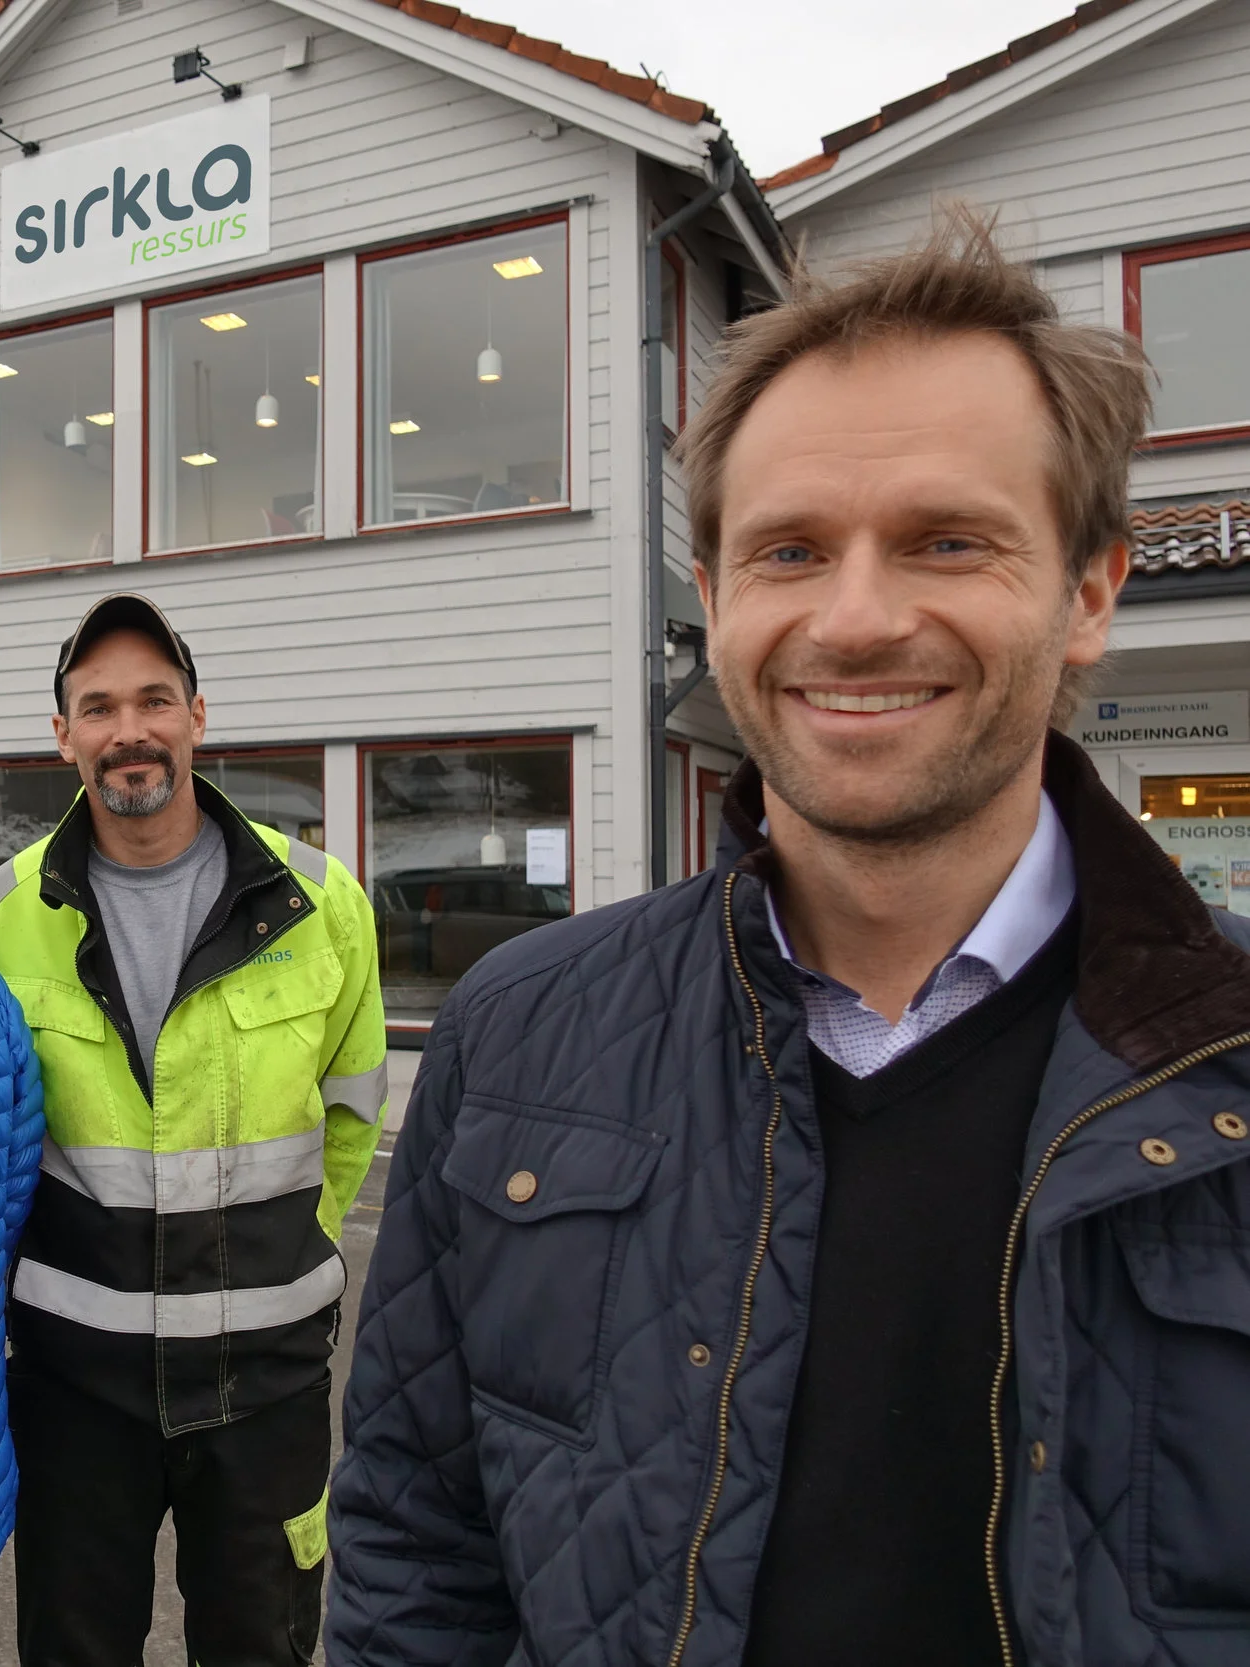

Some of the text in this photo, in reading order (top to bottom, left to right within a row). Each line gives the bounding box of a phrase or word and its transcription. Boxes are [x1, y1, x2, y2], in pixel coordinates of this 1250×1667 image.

[130, 213, 247, 265] ressurs
[1082, 725, 1229, 743] KUNDEINNGANG
[1168, 825, 1250, 839] ENGROS
